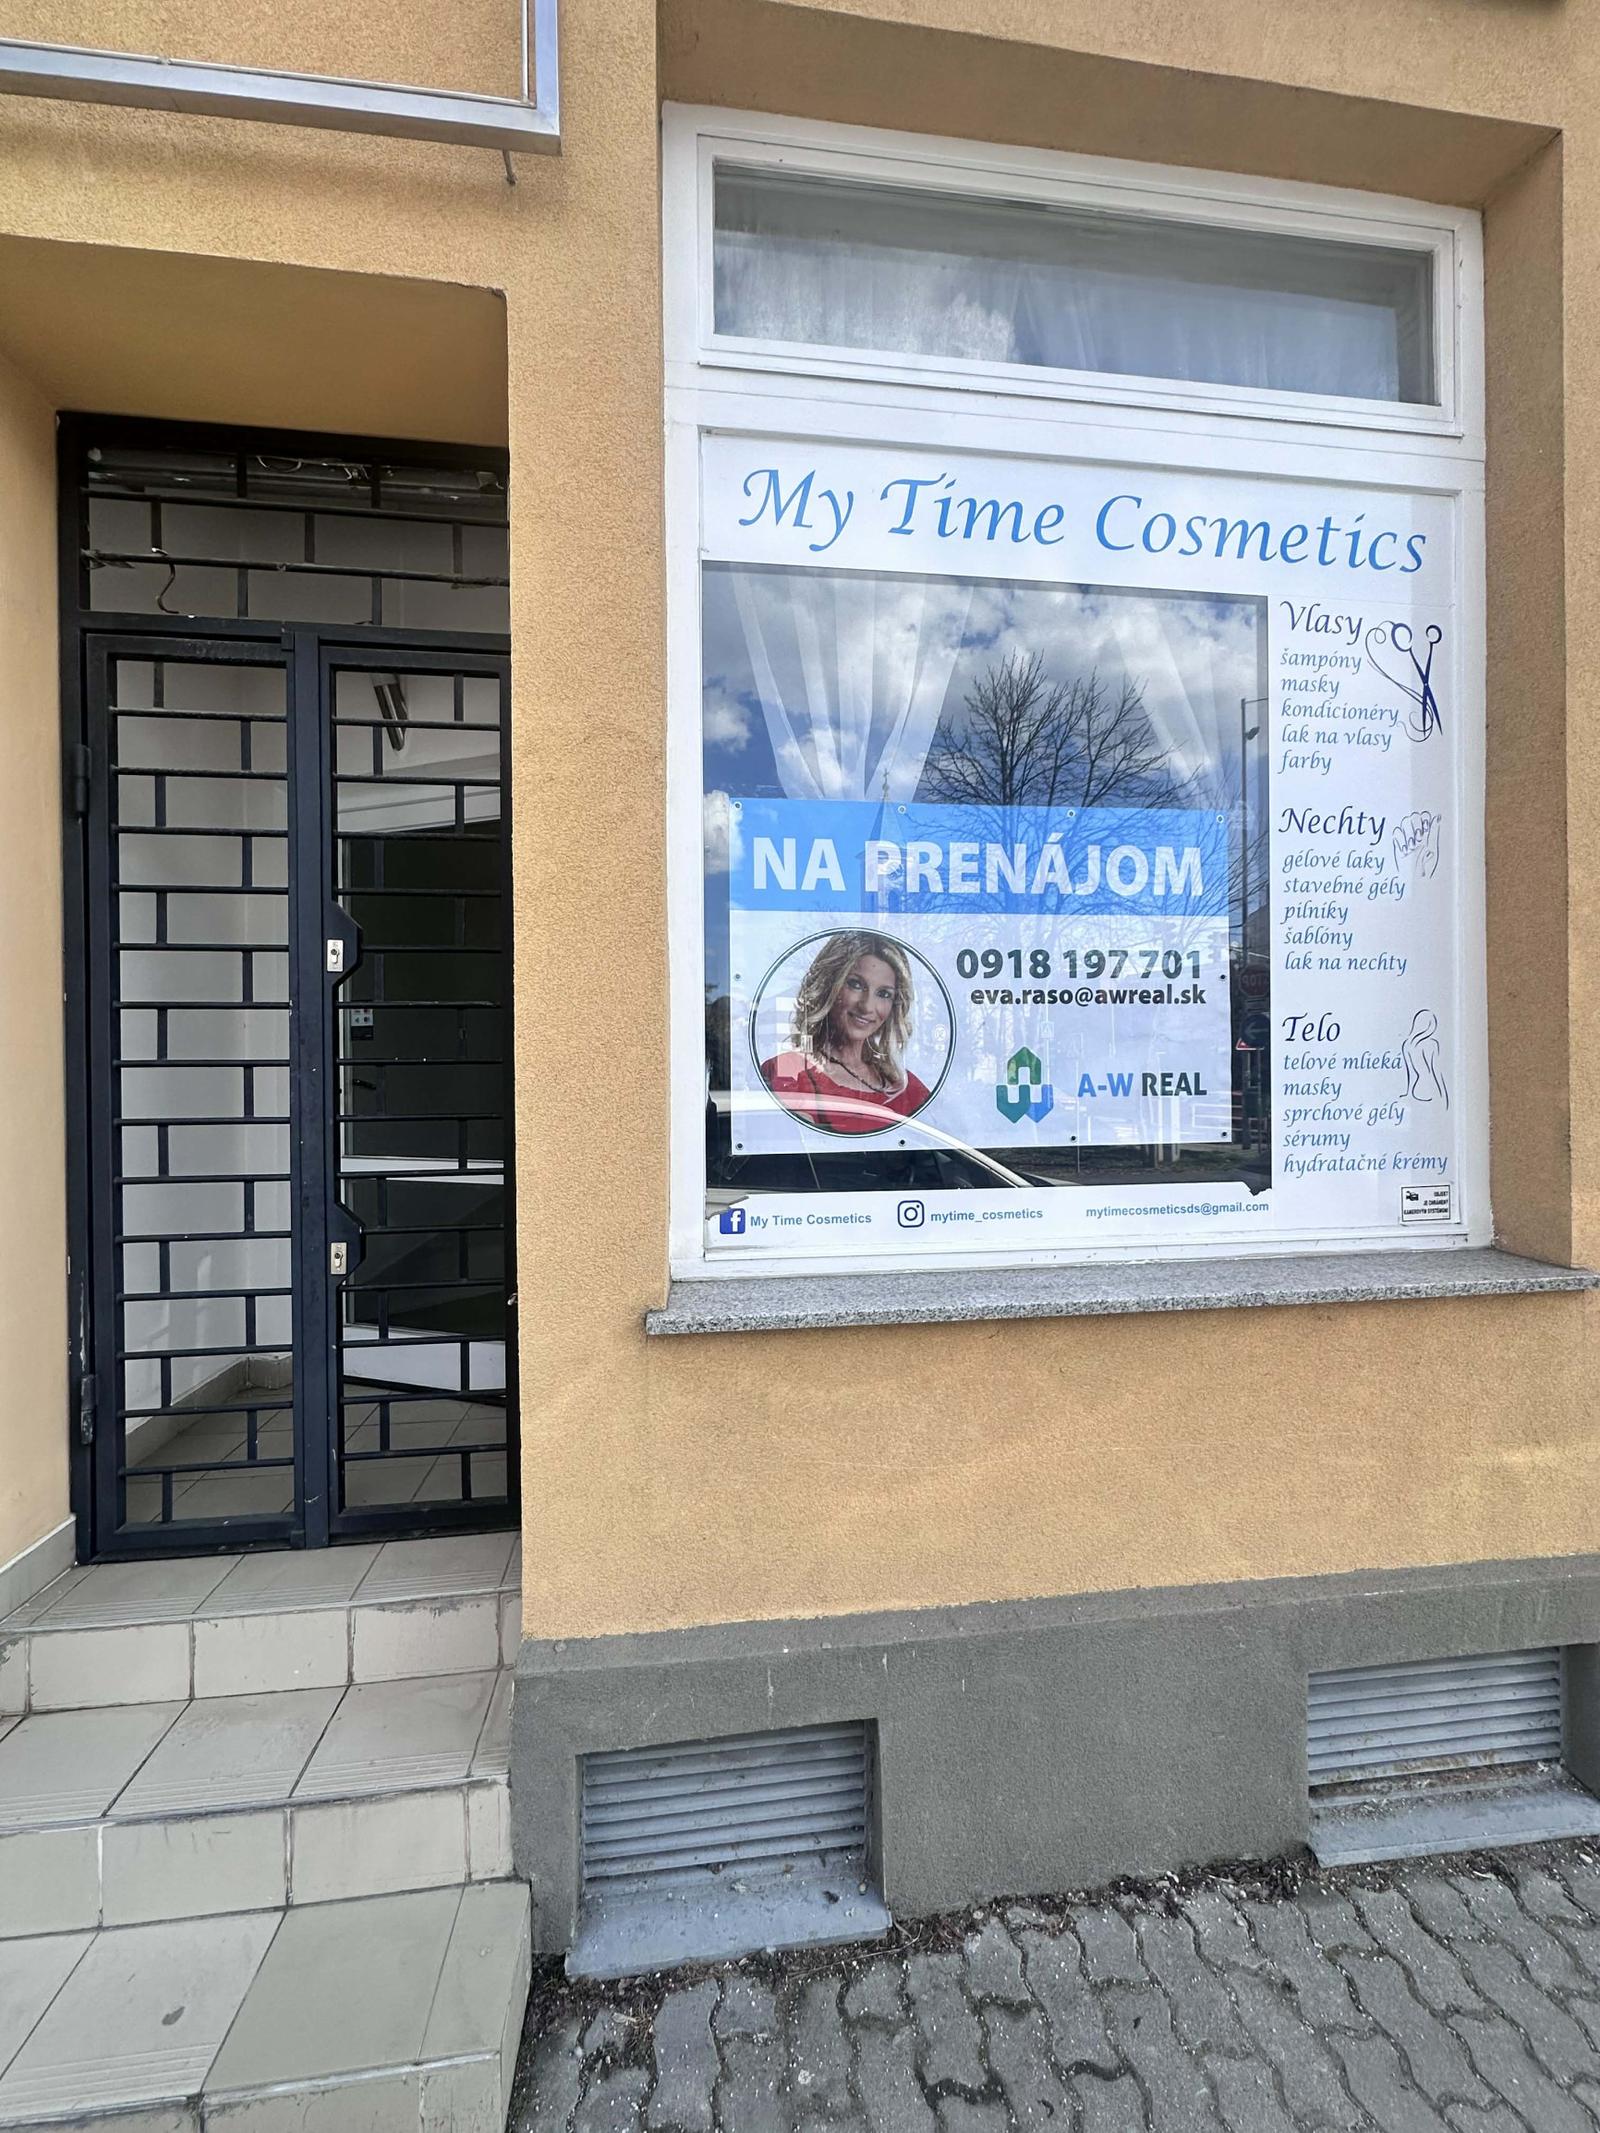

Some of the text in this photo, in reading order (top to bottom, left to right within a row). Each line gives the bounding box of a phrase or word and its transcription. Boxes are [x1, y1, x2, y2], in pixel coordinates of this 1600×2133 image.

[738, 469, 1427, 573] My Time Cosmetics
[1279, 601, 1363, 645] Vlasy
[1280, 648, 1362, 675] šampóny
[1281, 674, 1339, 699] masky
[1281, 698, 1399, 727] kondicionéry
[1282, 724, 1392, 752] lak na vlasy
[1277, 749, 1332, 776] farby
[1278, 806, 1386, 846] Nechty
[752, 832, 1204, 897] NA PRENÁJOM
[1282, 848, 1385, 875] gélové laky
[1283, 875, 1405, 901] stavebné gély
[1280, 900, 1348, 925] pilníky
[1284, 926, 1353, 951] šablóny
[956, 948, 1201, 979] 0918 197 701
[1285, 951, 1407, 976] lak na nechty
[970, 984, 1206, 1007] eva.raso@awreal.sk
[1282, 1012, 1341, 1042] Telo
[1283, 1051, 1402, 1070] telové mlieká
[1077, 1072, 1208, 1098] A-W REAL
[1283, 1076, 1342, 1101] masky
[1282, 1101, 1405, 1128] sprchové gély
[1282, 1130, 1351, 1152] sérumy
[1284, 1152, 1448, 1179] hydratačné krémy
[750, 1212, 872, 1229] My Time Cosmetics
[930, 1207, 1043, 1224] mytime_cosmetics
[1086, 1201, 1269, 1219] mytimecosmeticsds@gmail.com
